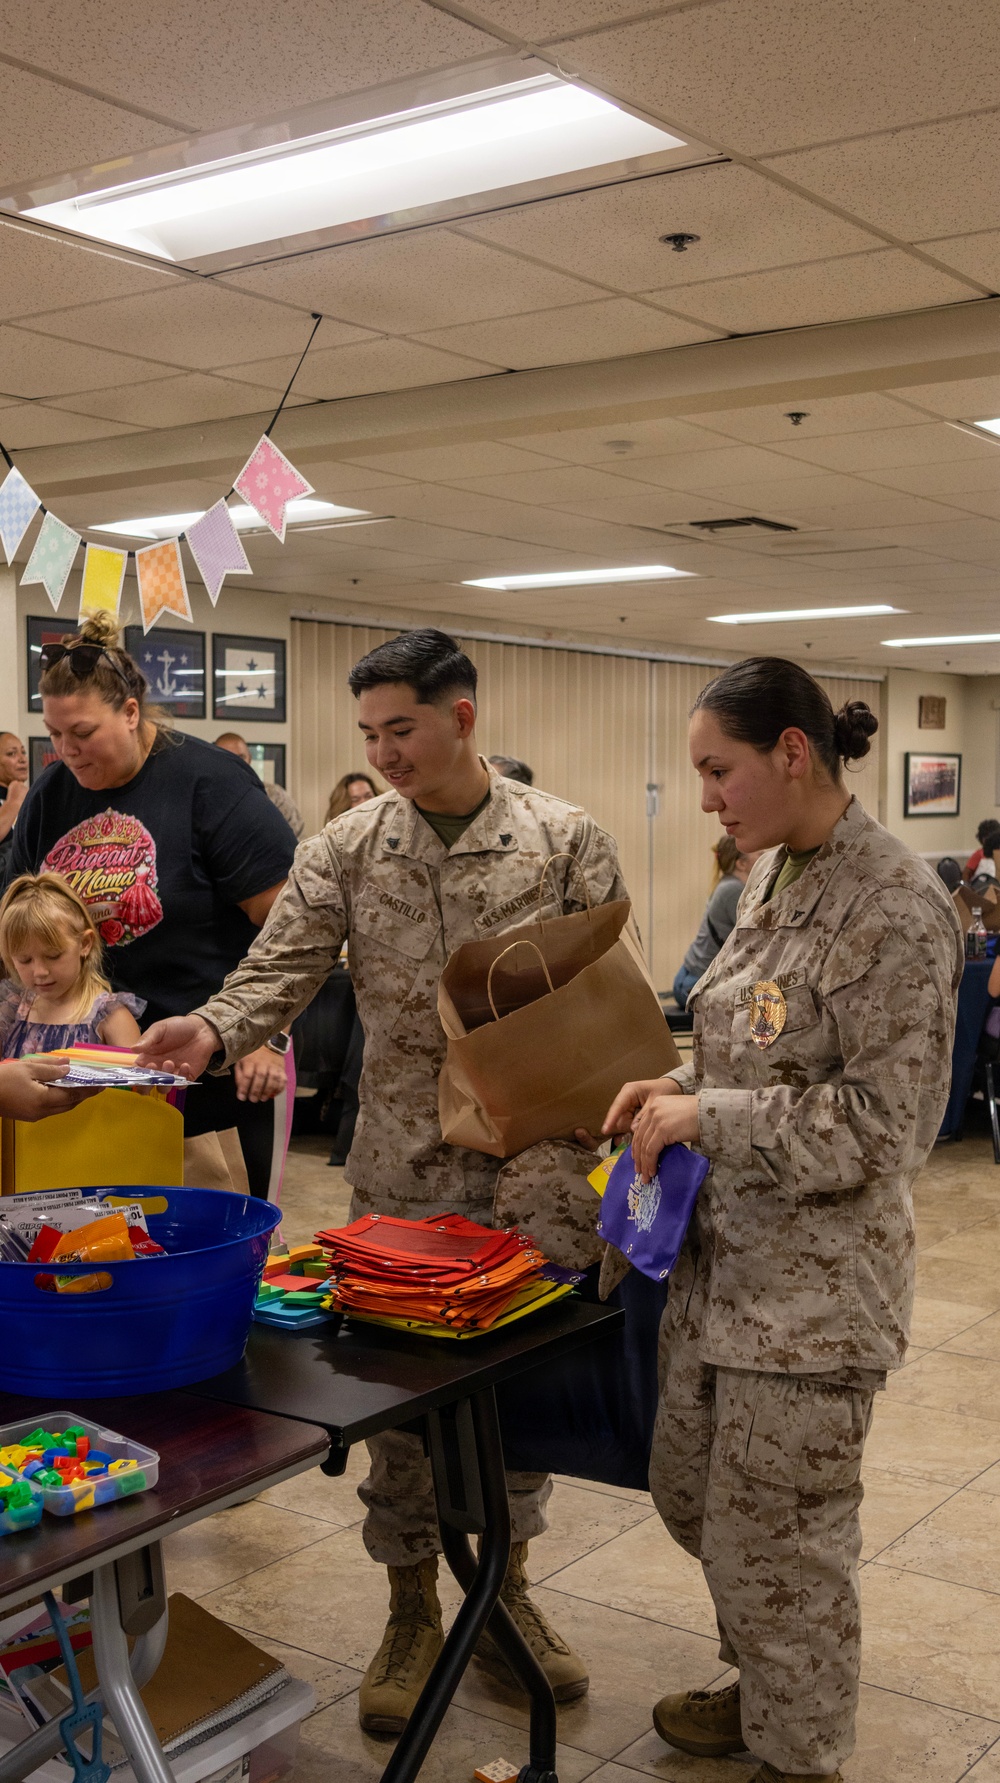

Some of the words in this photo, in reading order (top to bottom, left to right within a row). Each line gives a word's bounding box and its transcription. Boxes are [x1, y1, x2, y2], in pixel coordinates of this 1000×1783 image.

[46, 838, 151, 873] Pageant
[64, 868, 136, 898] Mama
[379, 893, 426, 924] CASTILLO
[482, 912, 502, 927] U.S.
[502, 887, 543, 917] MARINES
[740, 986, 754, 1001] U.S
[772, 970, 798, 988] INES
[131, 1211, 142, 1220] 10
[58, 1250, 77, 1262] BIC
